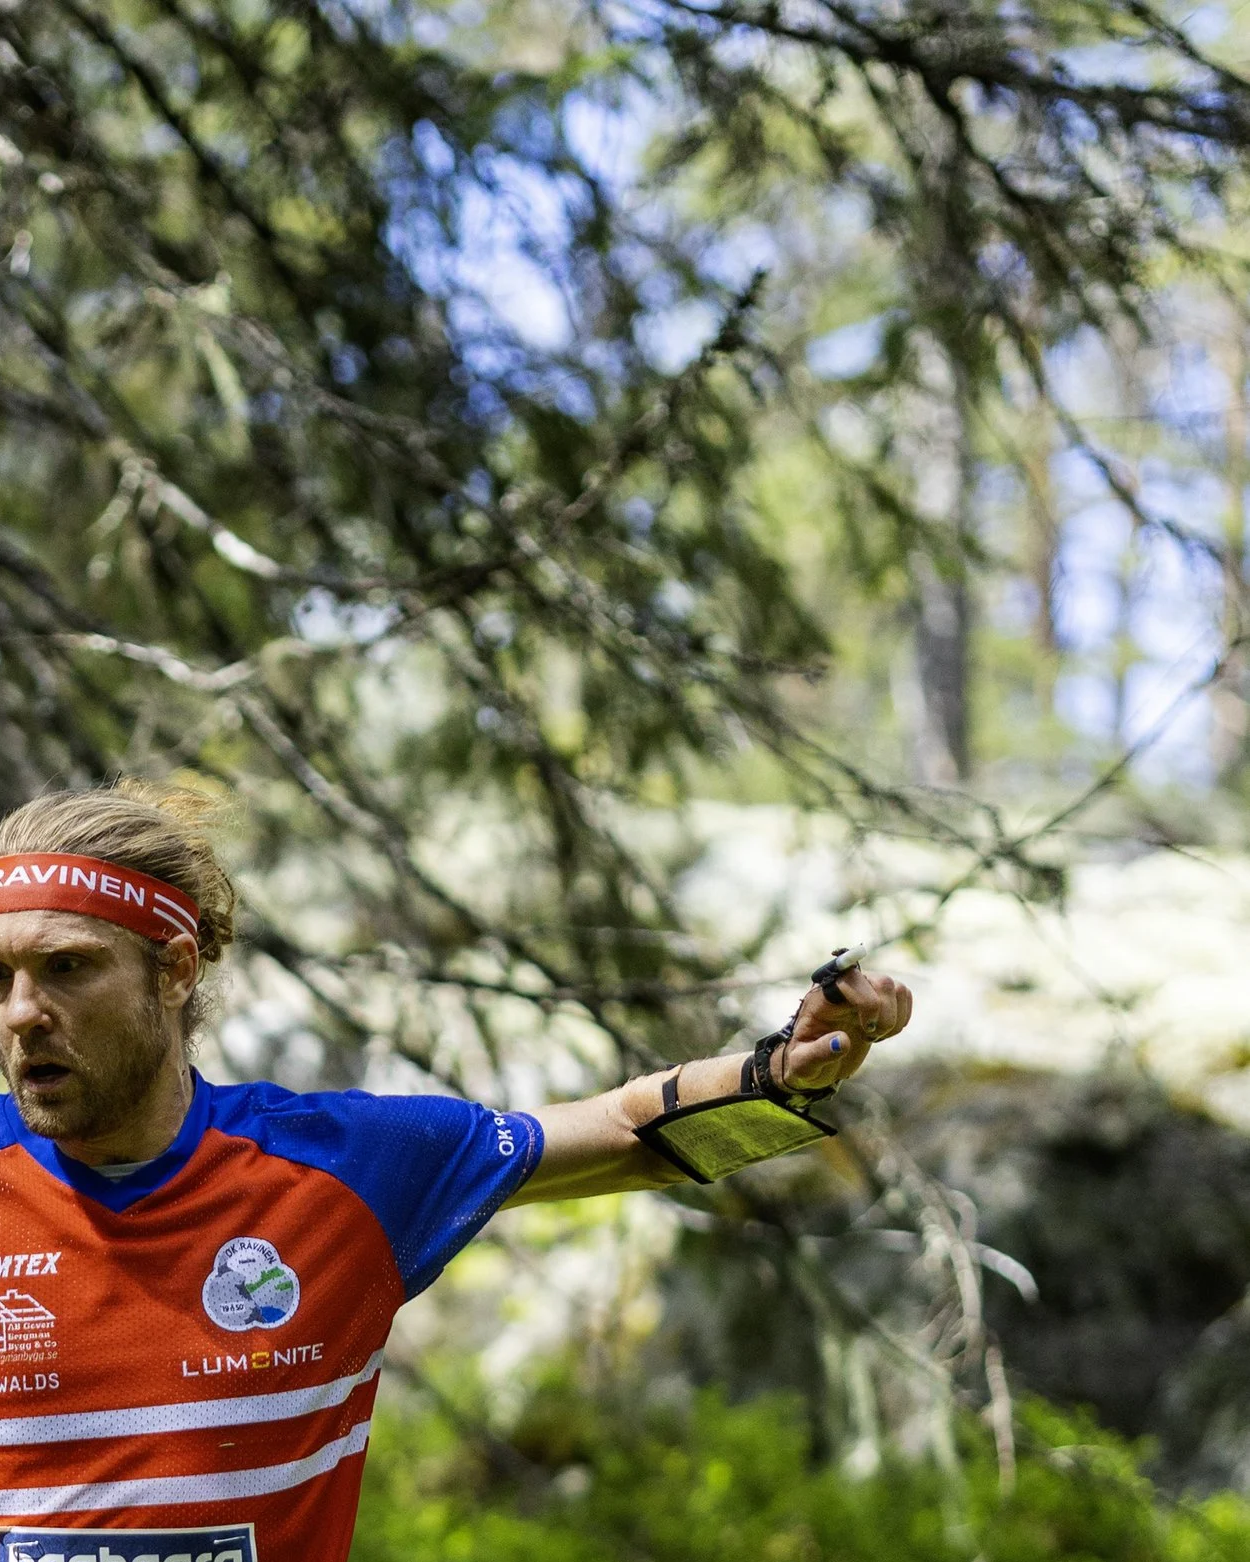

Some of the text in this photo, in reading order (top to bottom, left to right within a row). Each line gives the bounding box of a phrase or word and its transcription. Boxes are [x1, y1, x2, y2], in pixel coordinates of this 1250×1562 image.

[498, 1129, 515, 1156] OK
[225, 1242, 277, 1264] OK RAVINEN
[8, 1332, 51, 1341] Bergman
[34, 1340, 42, 1349] &
[44, 1340, 57, 1349] Co
[182, 1343, 324, 1377] LUMONITE
